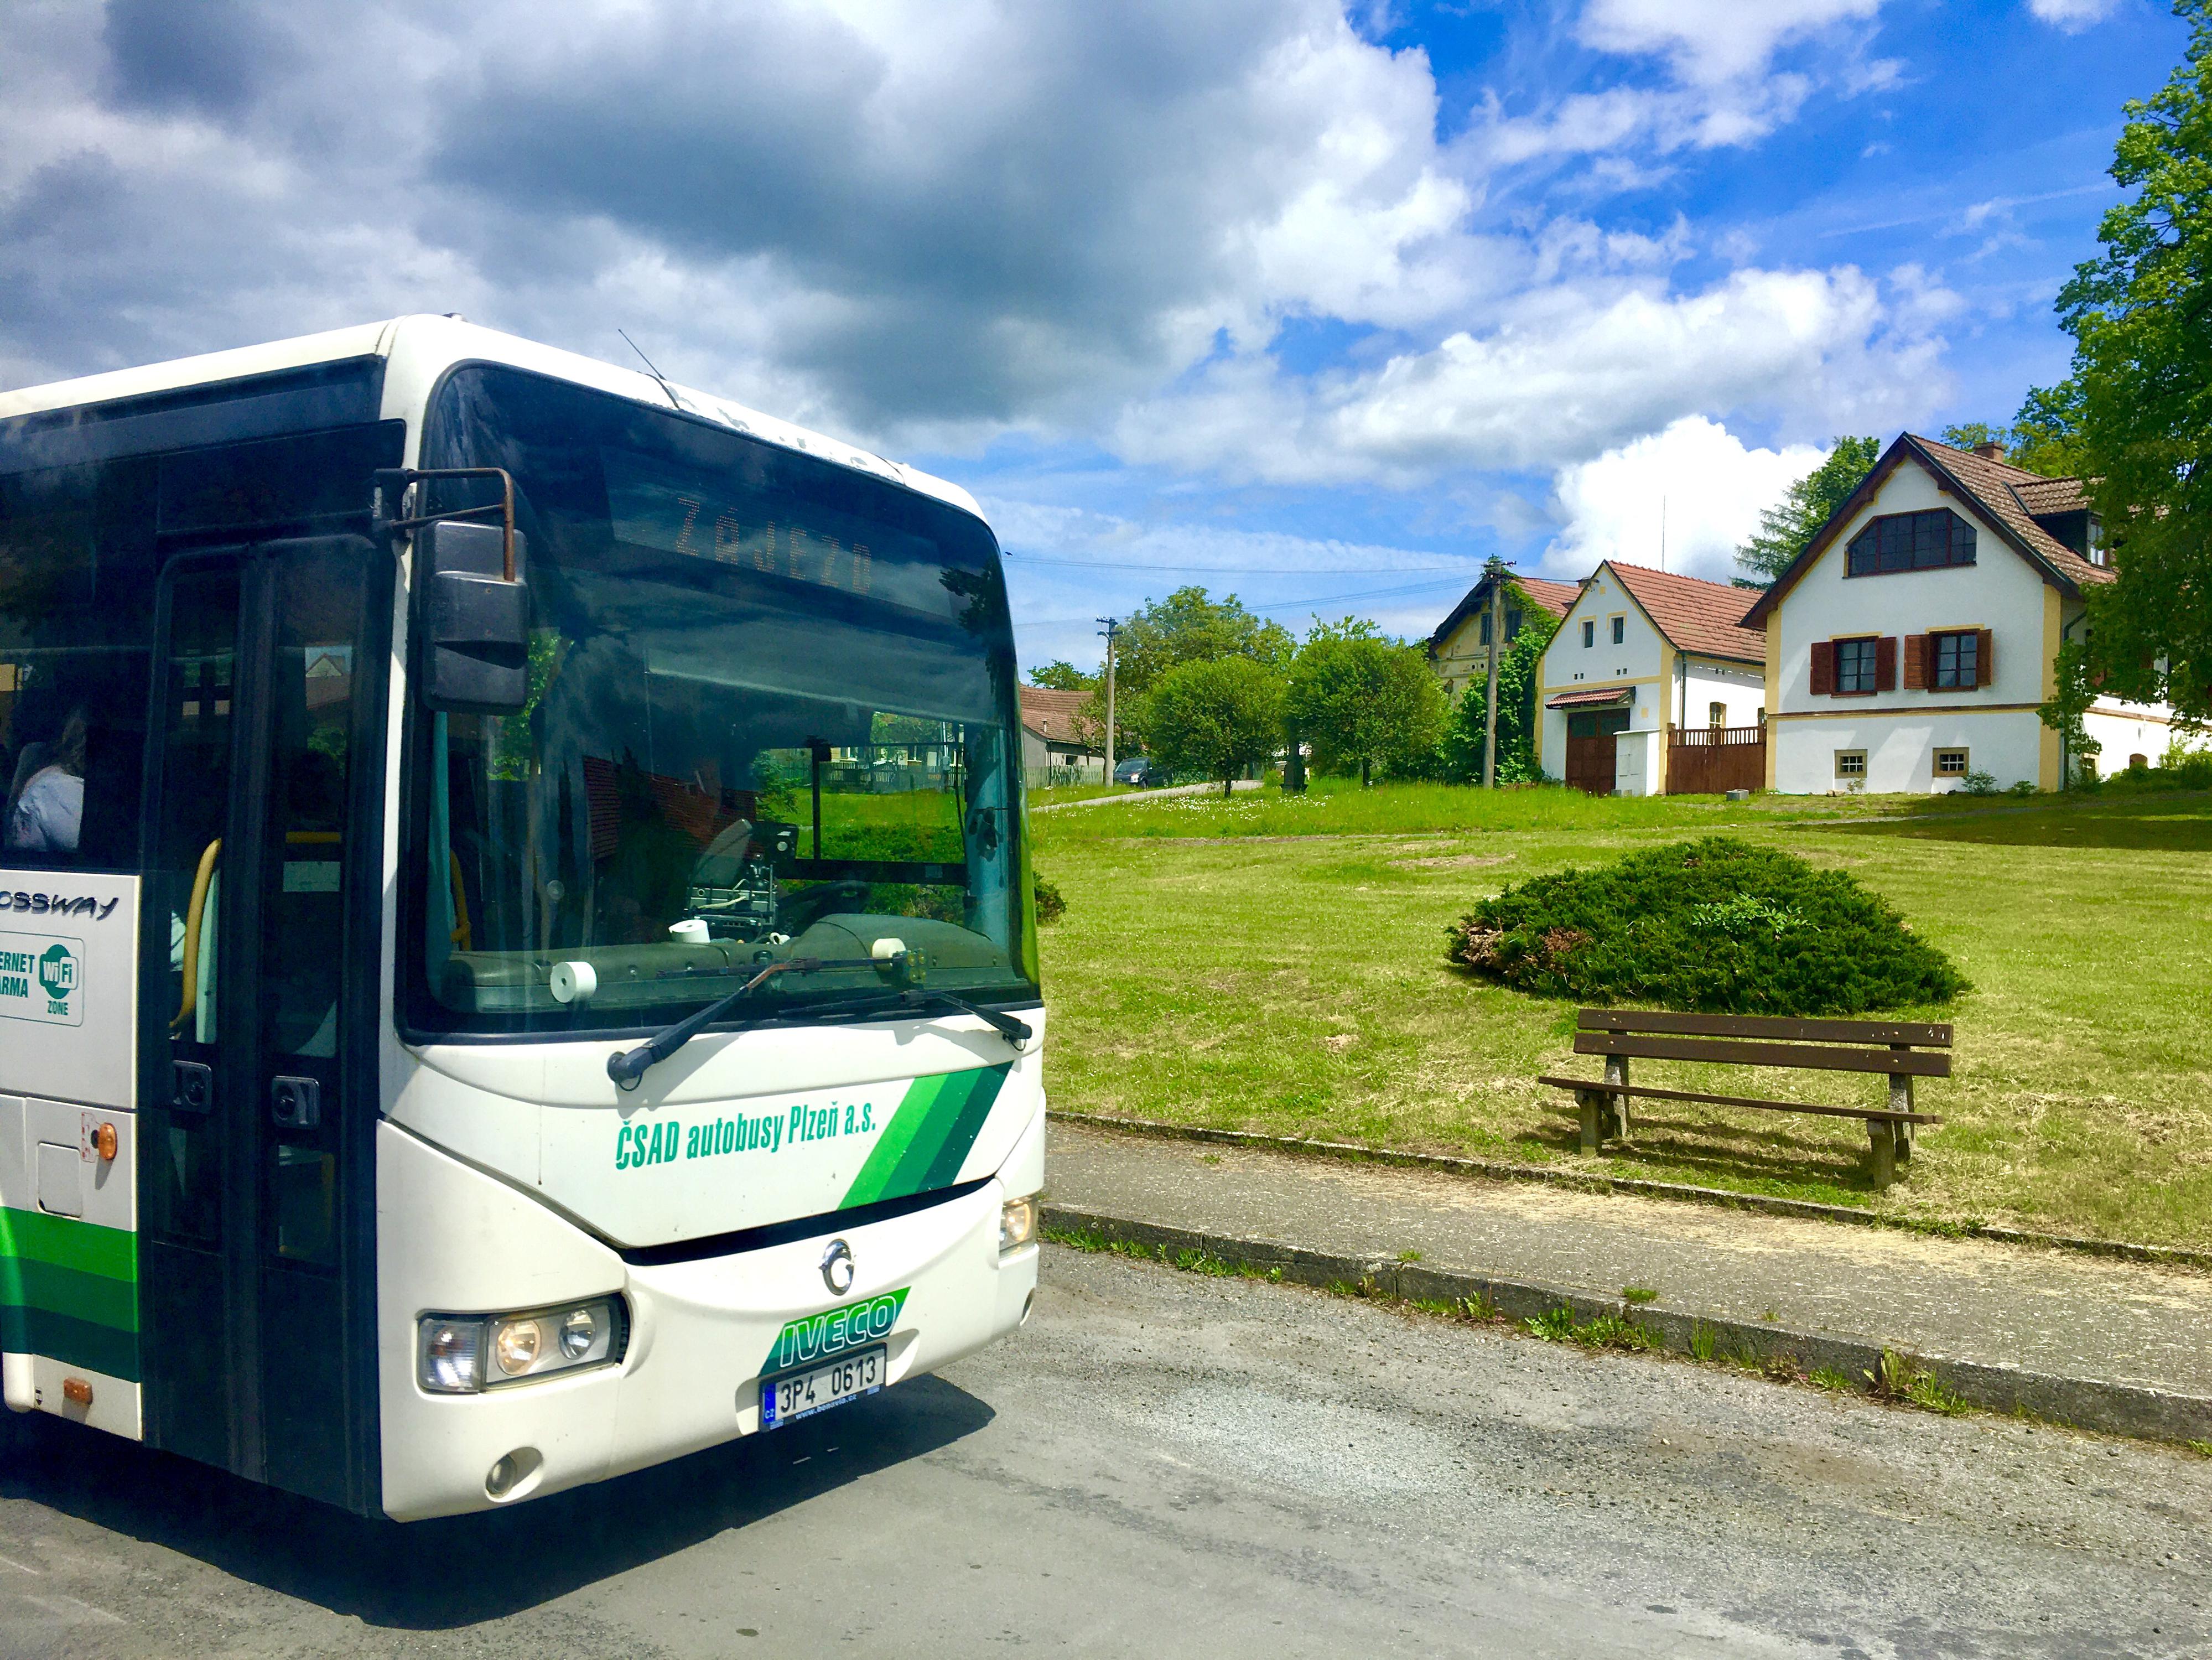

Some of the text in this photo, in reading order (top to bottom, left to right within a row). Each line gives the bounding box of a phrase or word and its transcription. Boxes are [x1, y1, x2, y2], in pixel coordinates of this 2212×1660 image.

[676, 497, 871, 595] ZÁJEZD
[0, 976, 28, 998] RMA
[43, 961, 72, 983] WiFi
[47, 1000, 69, 1016] ZONE
[615, 1100, 876, 1170] ČSAD autobusy Plzeň a.s.
[780, 1295, 897, 1368] IVECO
[780, 1356, 876, 1413] 3P4 0613
